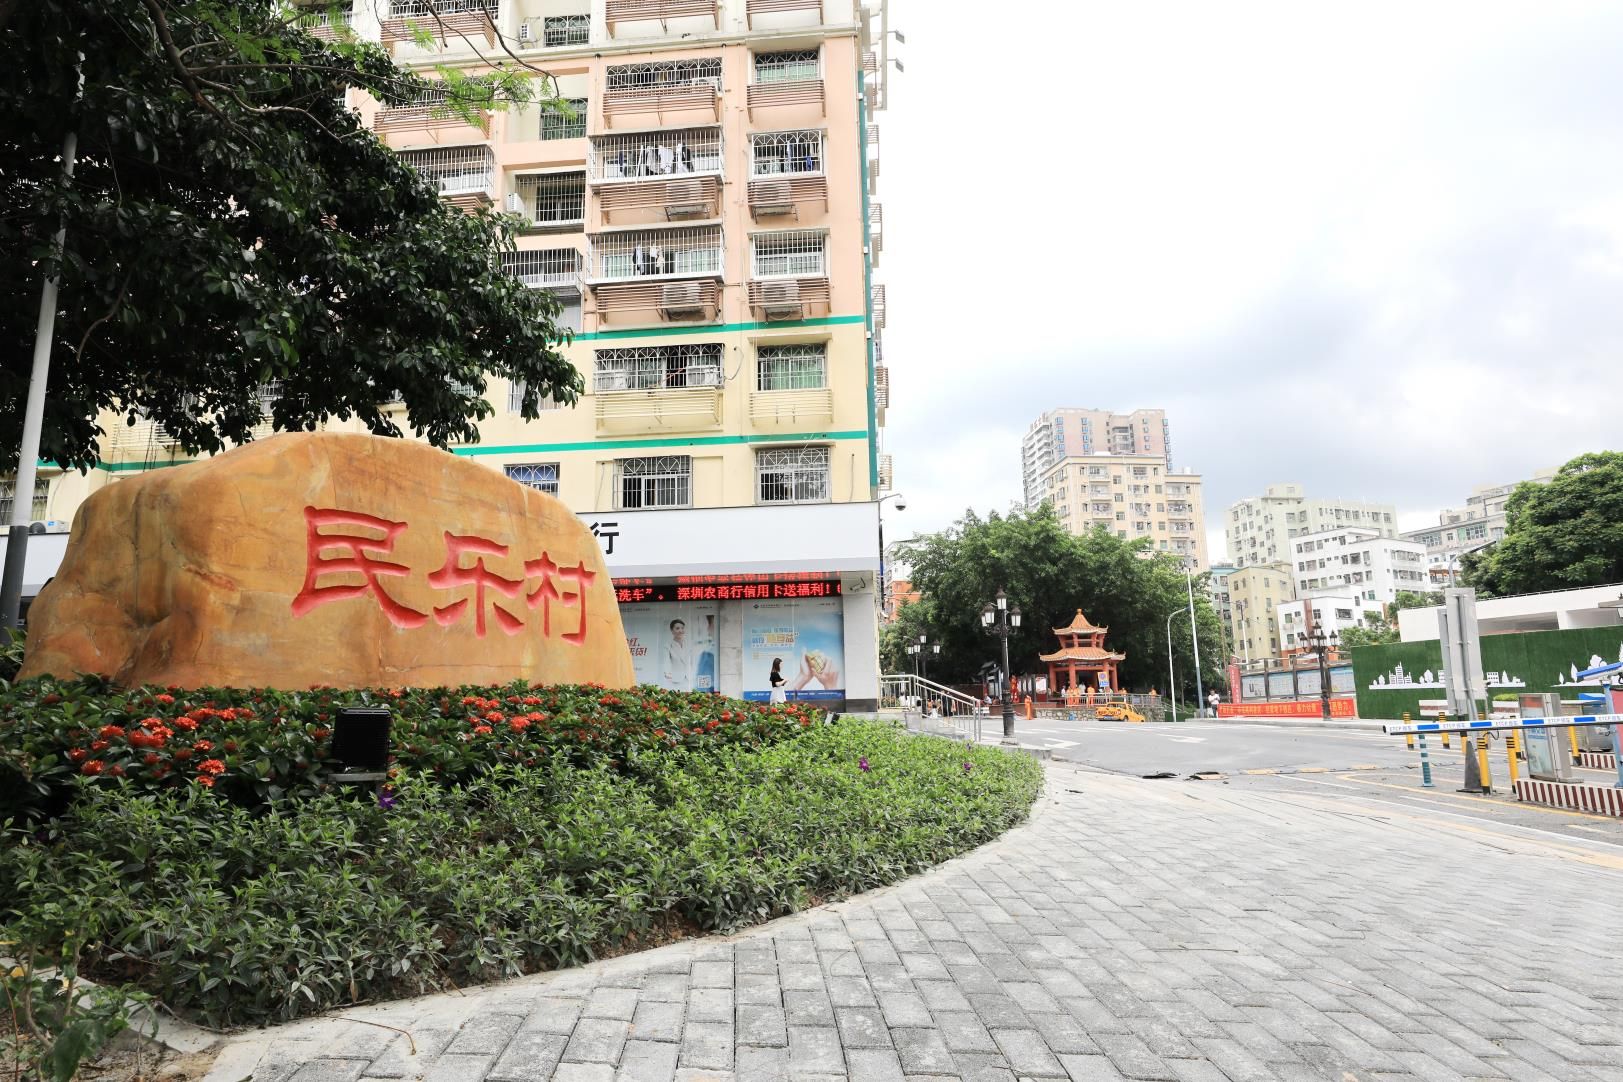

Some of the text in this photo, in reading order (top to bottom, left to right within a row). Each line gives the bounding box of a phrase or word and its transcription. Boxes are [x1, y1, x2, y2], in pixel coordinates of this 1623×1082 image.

[291, 505, 596, 647] 民乐村
[590, 522, 620, 554] 行
